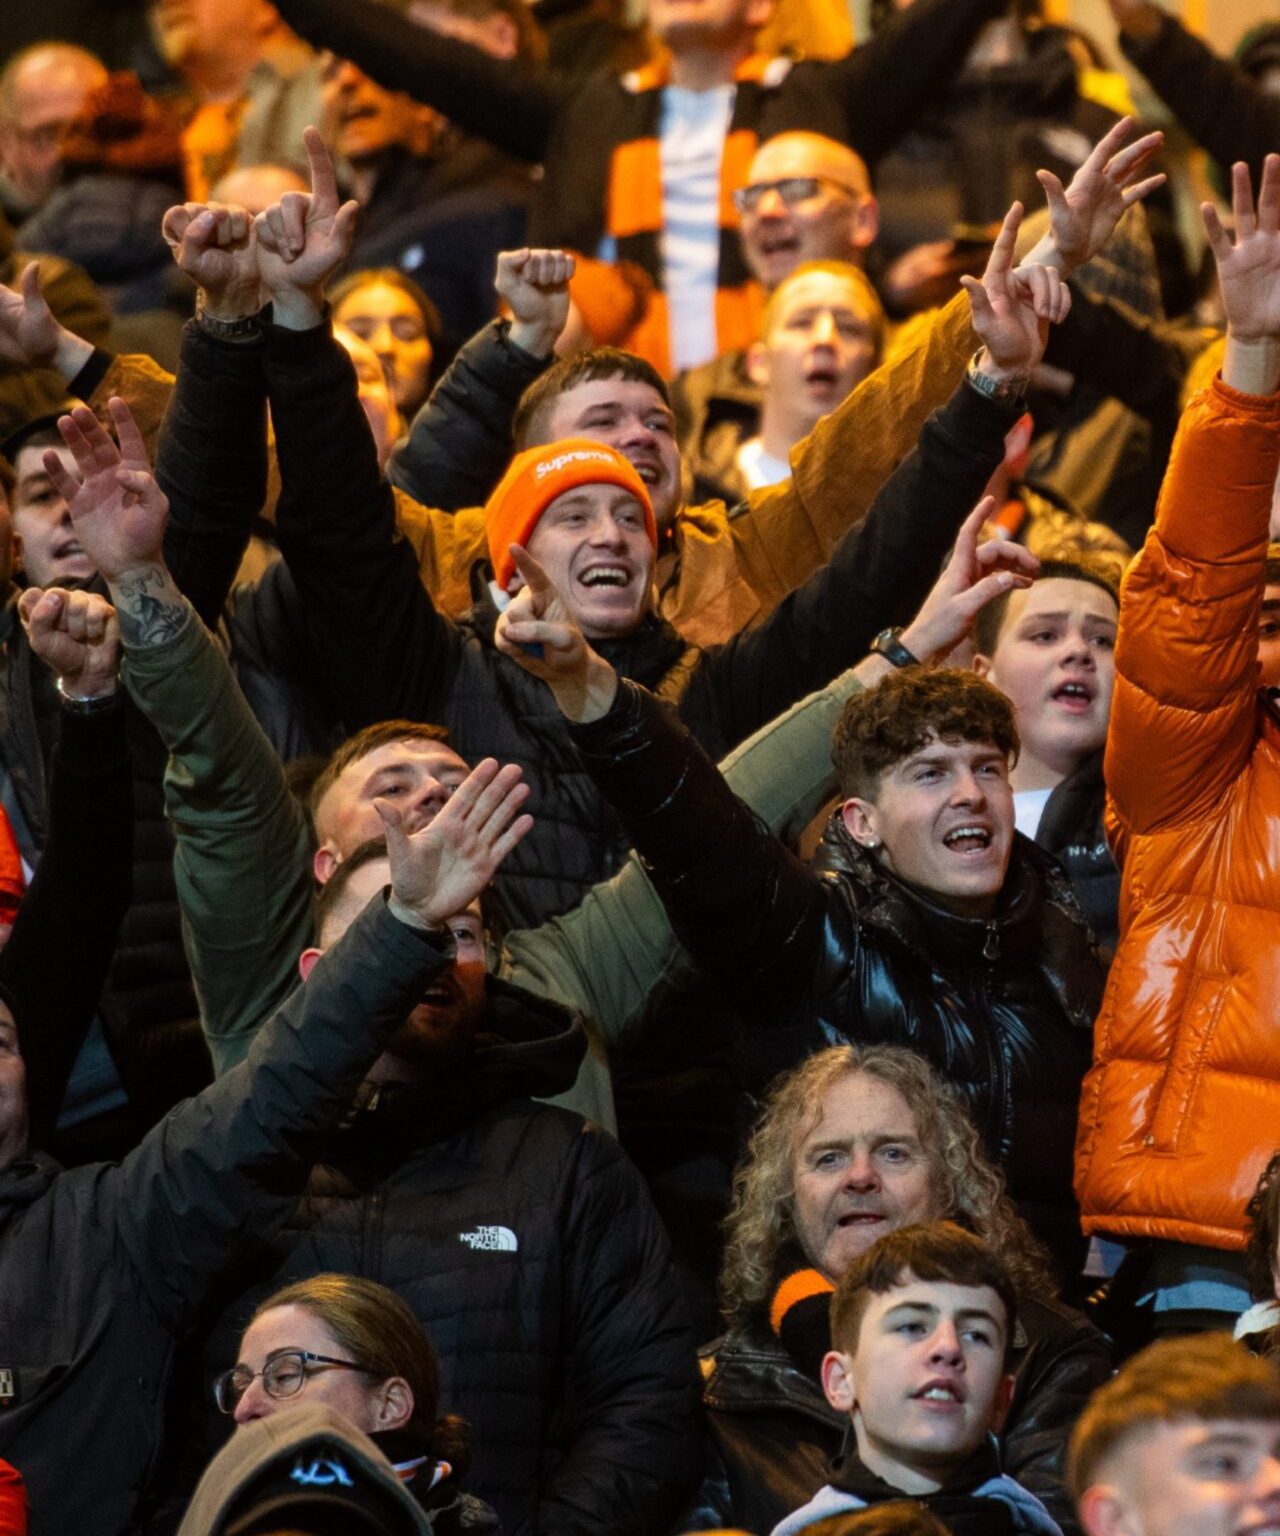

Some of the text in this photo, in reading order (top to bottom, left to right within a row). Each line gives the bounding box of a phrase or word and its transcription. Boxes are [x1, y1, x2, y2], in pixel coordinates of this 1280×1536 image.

[535, 452, 613, 479] Supreme
[476, 1225, 498, 1233] THE
[459, 1232, 498, 1242] NORTH
[470, 1241, 498, 1250] FACE
